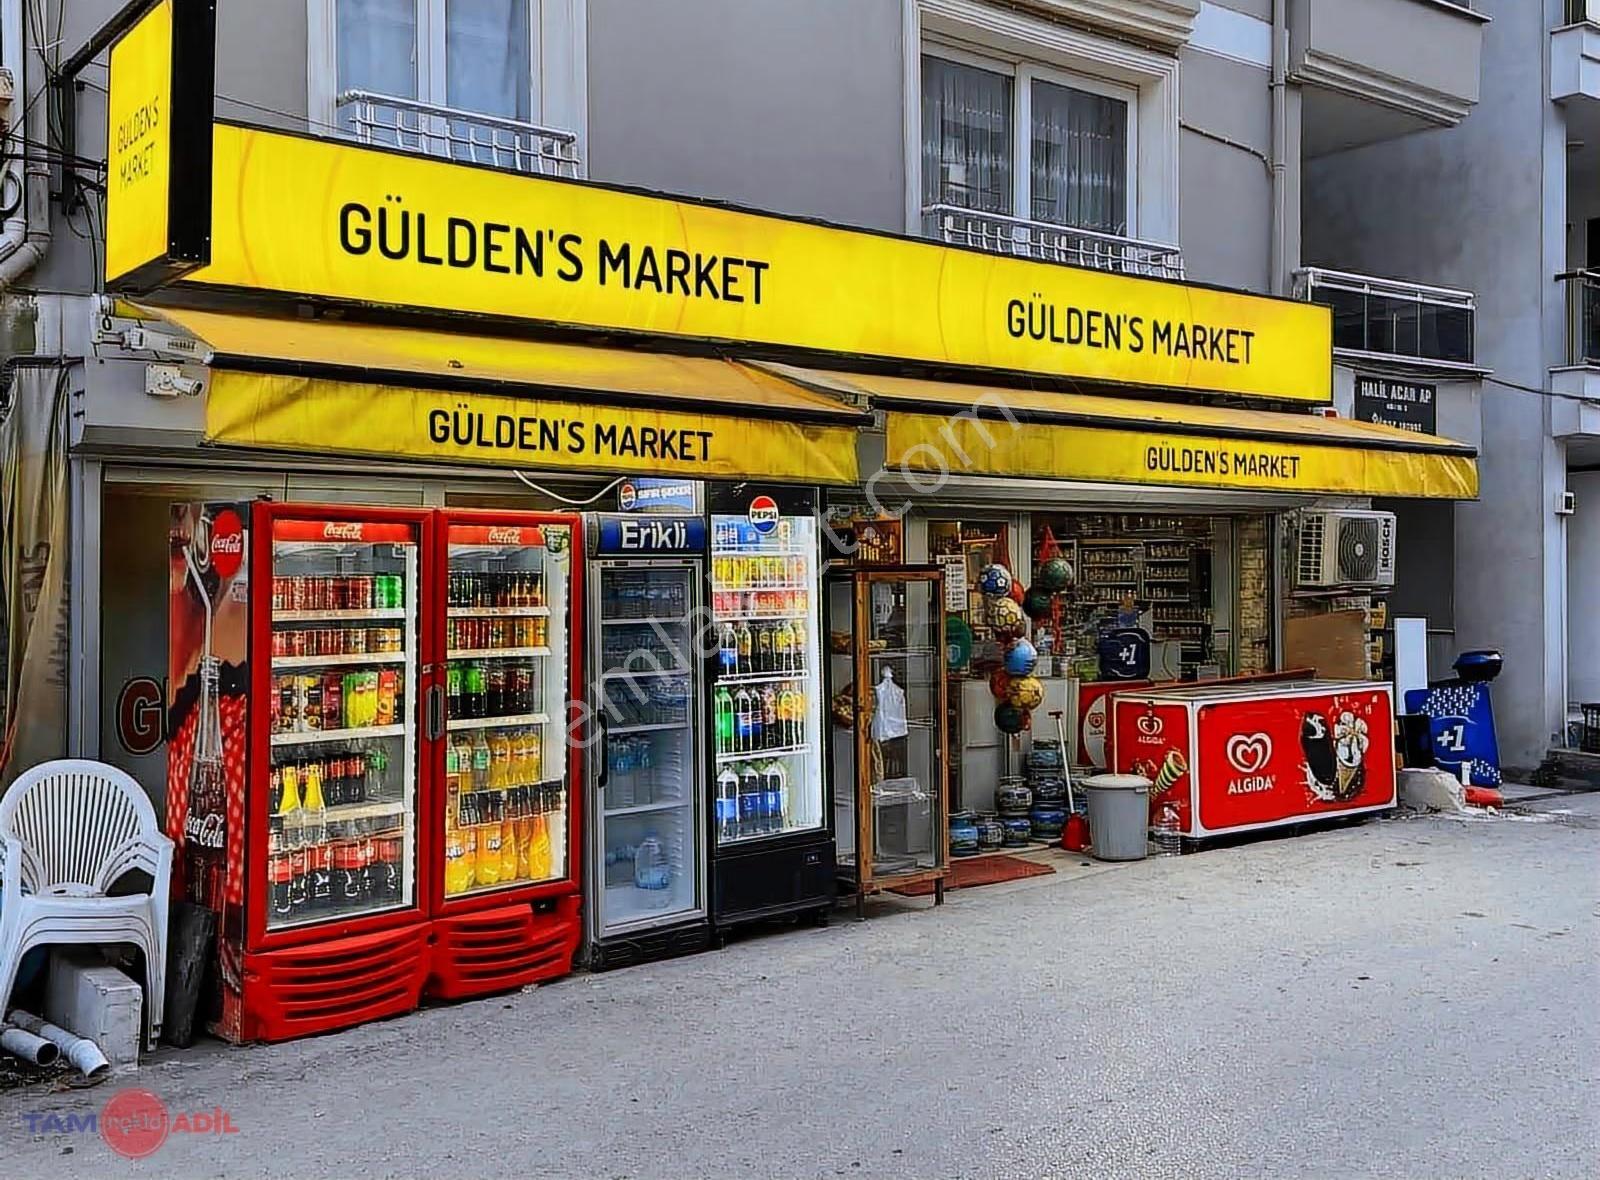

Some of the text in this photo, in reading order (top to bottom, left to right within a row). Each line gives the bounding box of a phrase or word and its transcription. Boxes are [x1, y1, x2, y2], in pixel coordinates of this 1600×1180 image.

[339, 194, 770, 305] GÜLDEN'S MARKET
[1007, 292, 1256, 365] GÜLDEN'S MARKET
[428, 393, 713, 462] GÜLDEN'S MARKET
[1146, 440, 1300, 479] GÜLDEN'S MARKET
[620, 520, 687, 549] Erikli
[751, 510, 777, 520] PEPSI
[1436, 724, 1466, 752] +1
